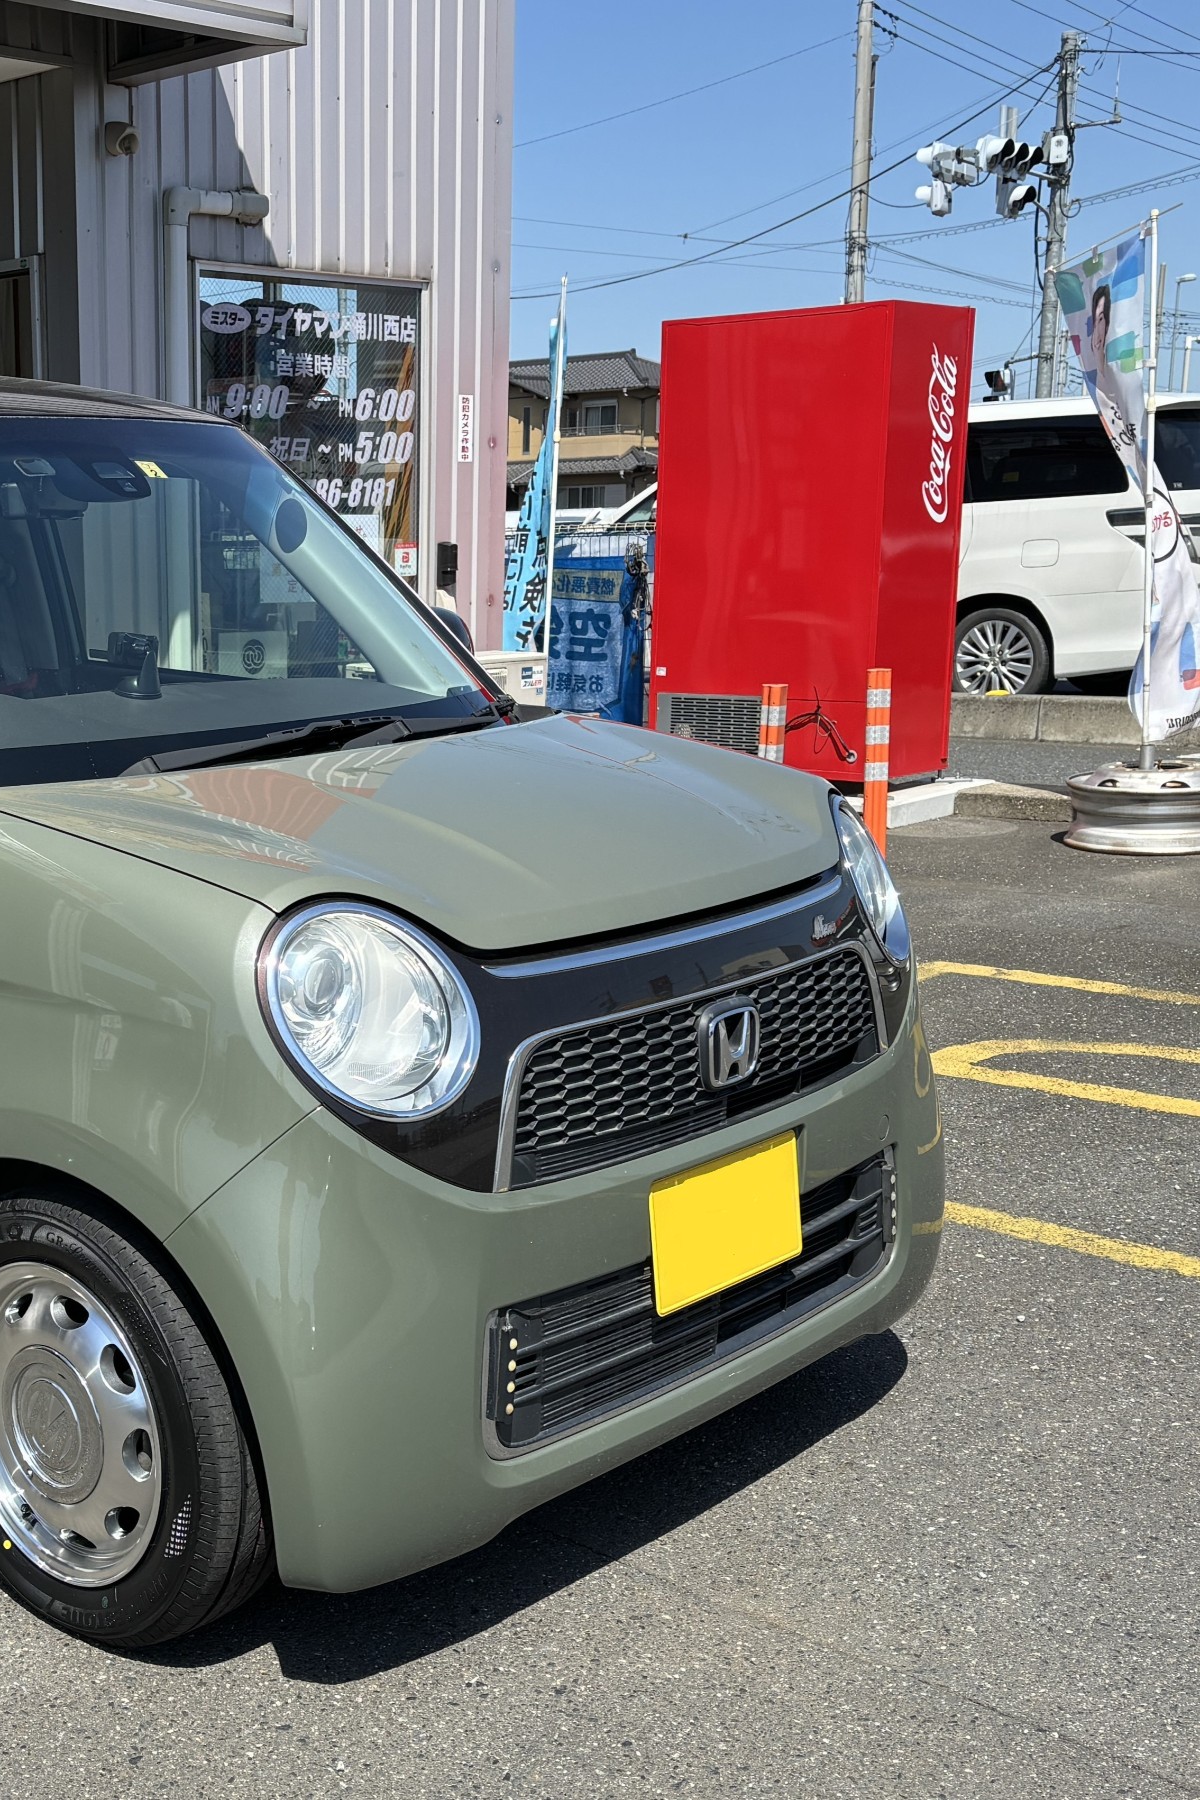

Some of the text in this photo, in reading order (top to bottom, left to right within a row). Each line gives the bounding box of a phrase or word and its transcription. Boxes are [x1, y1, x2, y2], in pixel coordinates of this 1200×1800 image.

[210, 310, 246, 326] ミスター
[255, 306, 344, 339] タイヤマン
[276, 353, 350, 379] 営業時間
[206, 396, 220, 416] AM
[223, 383, 290, 420] 9:00
[338, 400, 353, 418] PM
[354, 387, 416, 422] 6:00
[461, 396, 470, 461] 防犯カメラ作動中
[269, 436, 311, 463] 祝日
[338, 443, 353, 463] PM
[354, 431, 415, 464] 5:00
